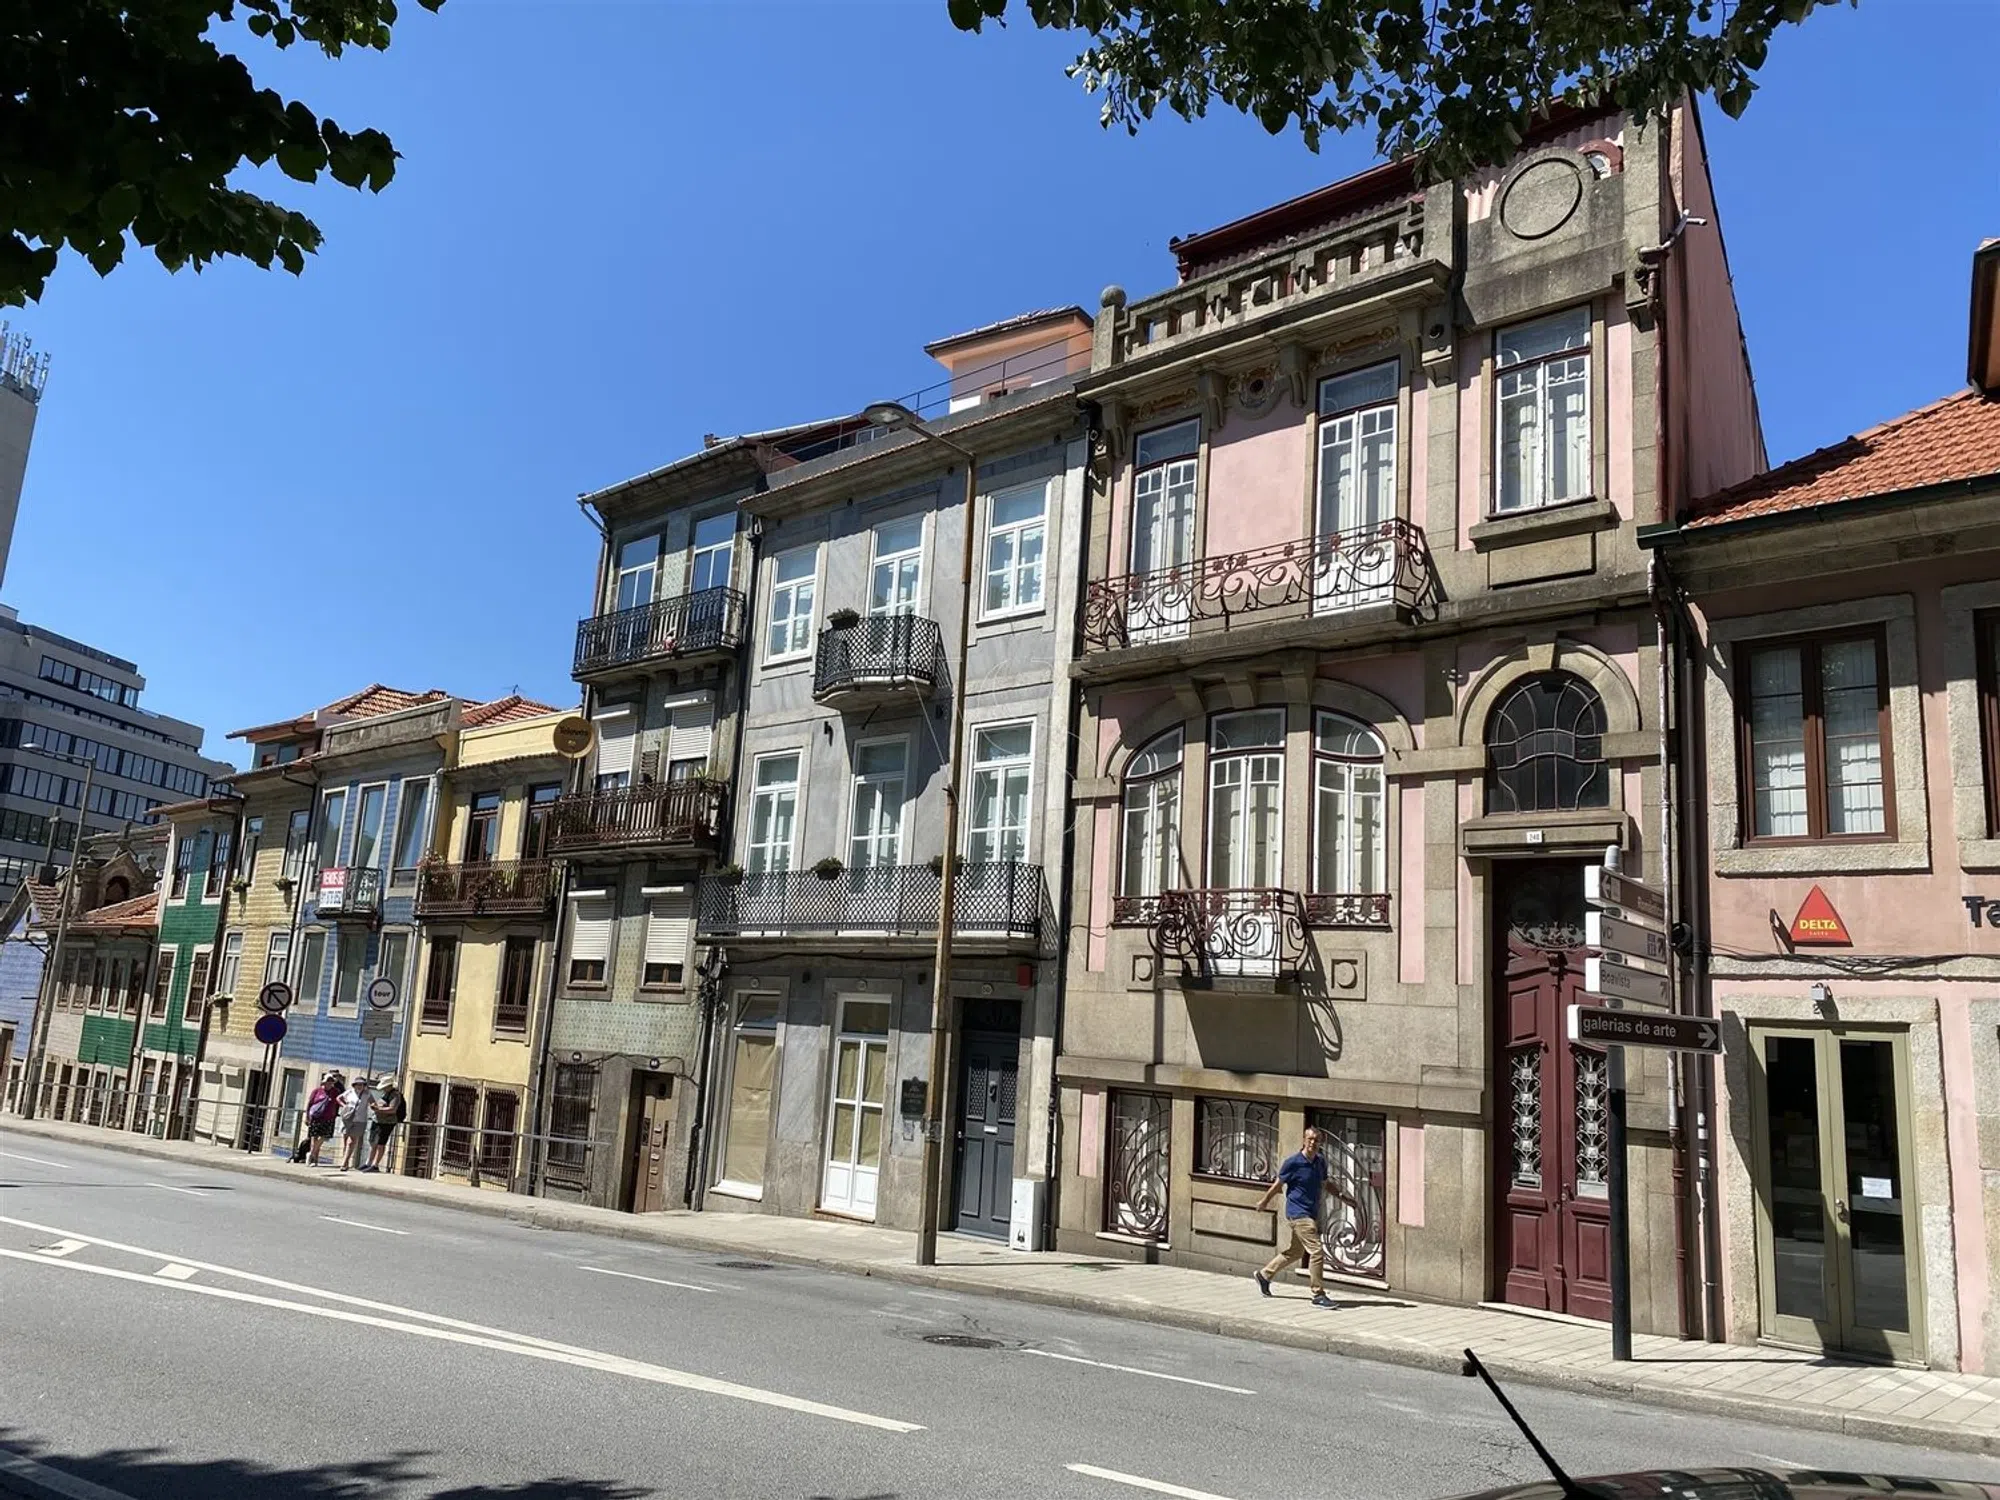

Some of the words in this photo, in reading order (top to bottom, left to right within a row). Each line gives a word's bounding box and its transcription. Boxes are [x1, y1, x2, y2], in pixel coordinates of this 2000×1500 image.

[1799, 919, 1838, 930] DELTA
[1601, 969, 1631, 989] Boavista
[1583, 1017, 1632, 1033] galerias
[1635, 1021, 1650, 1035] de
[1653, 1024, 1677, 1038] arte
